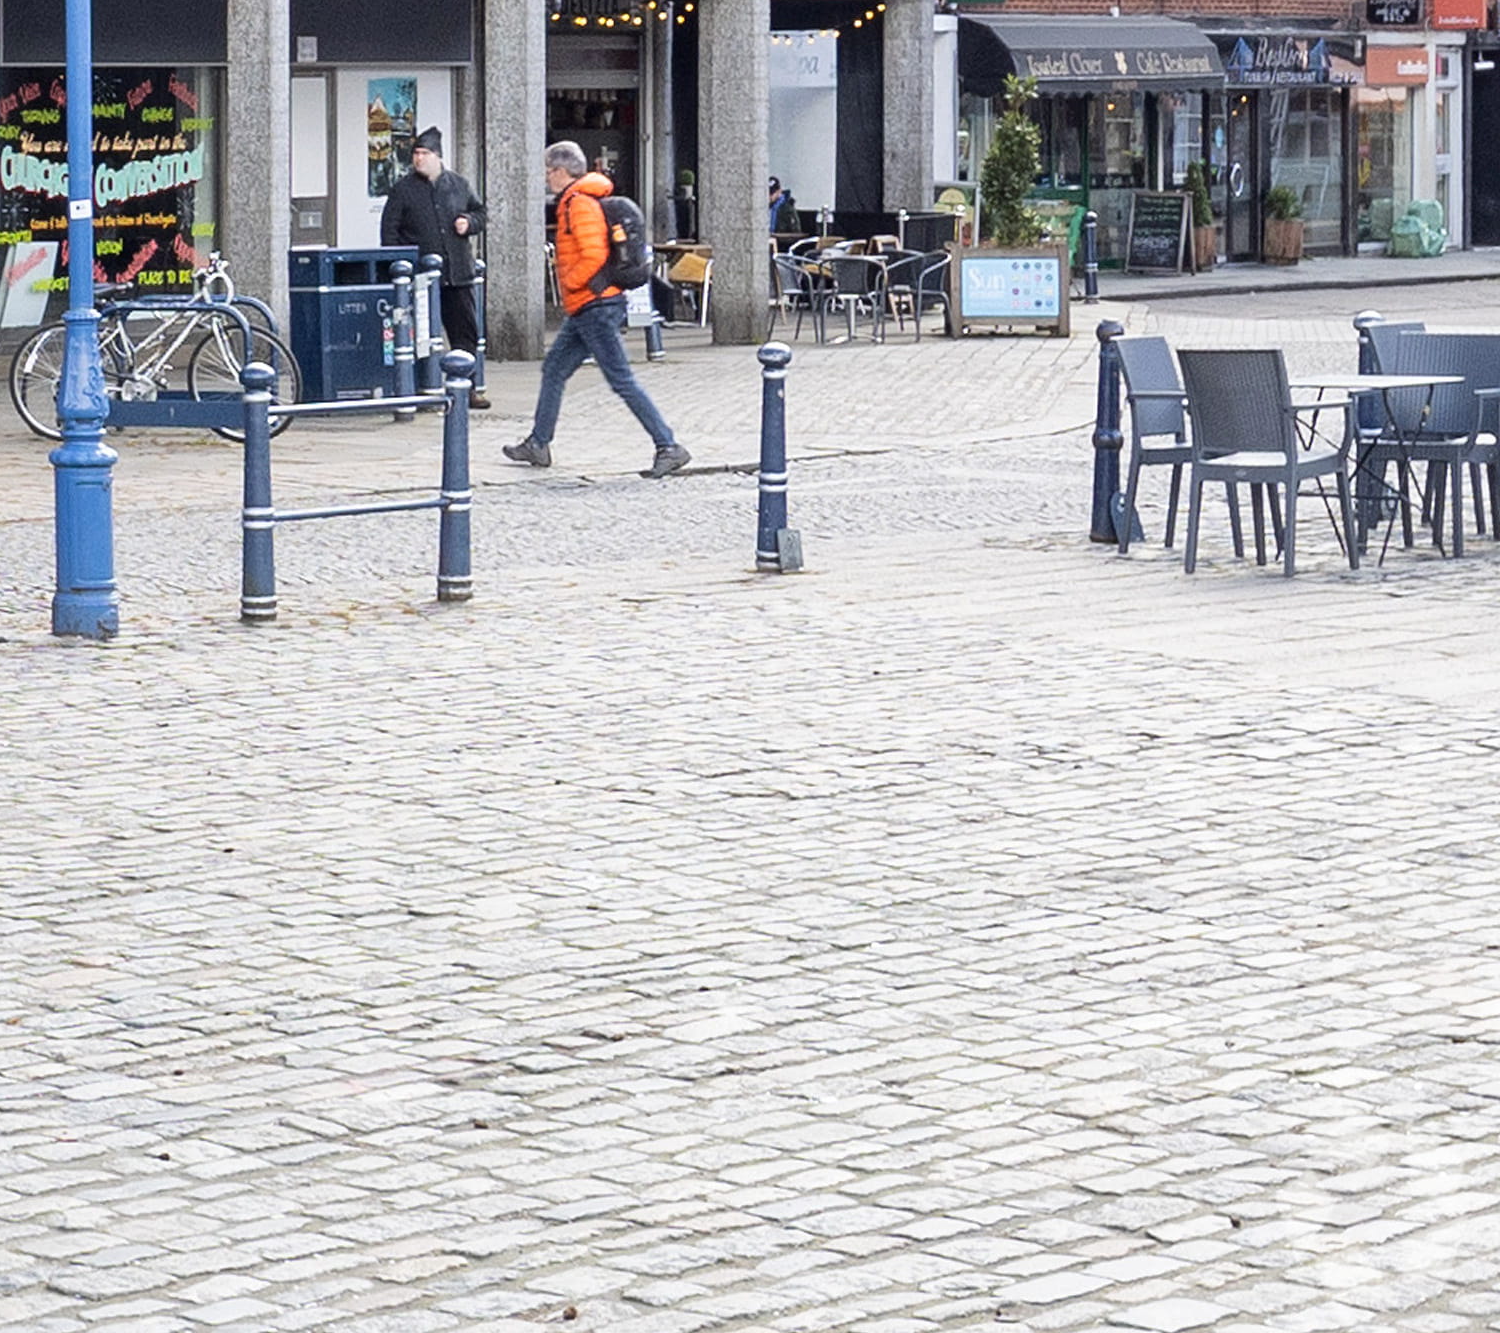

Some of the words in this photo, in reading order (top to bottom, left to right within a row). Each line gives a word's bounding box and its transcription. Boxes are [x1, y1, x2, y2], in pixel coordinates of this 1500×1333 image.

[20, 131, 42, 155] You
[44, 140, 62, 152] are
[112, 132, 133, 151] take
[132, 135, 158, 159] part
[339, 302, 367, 315] LITTER
